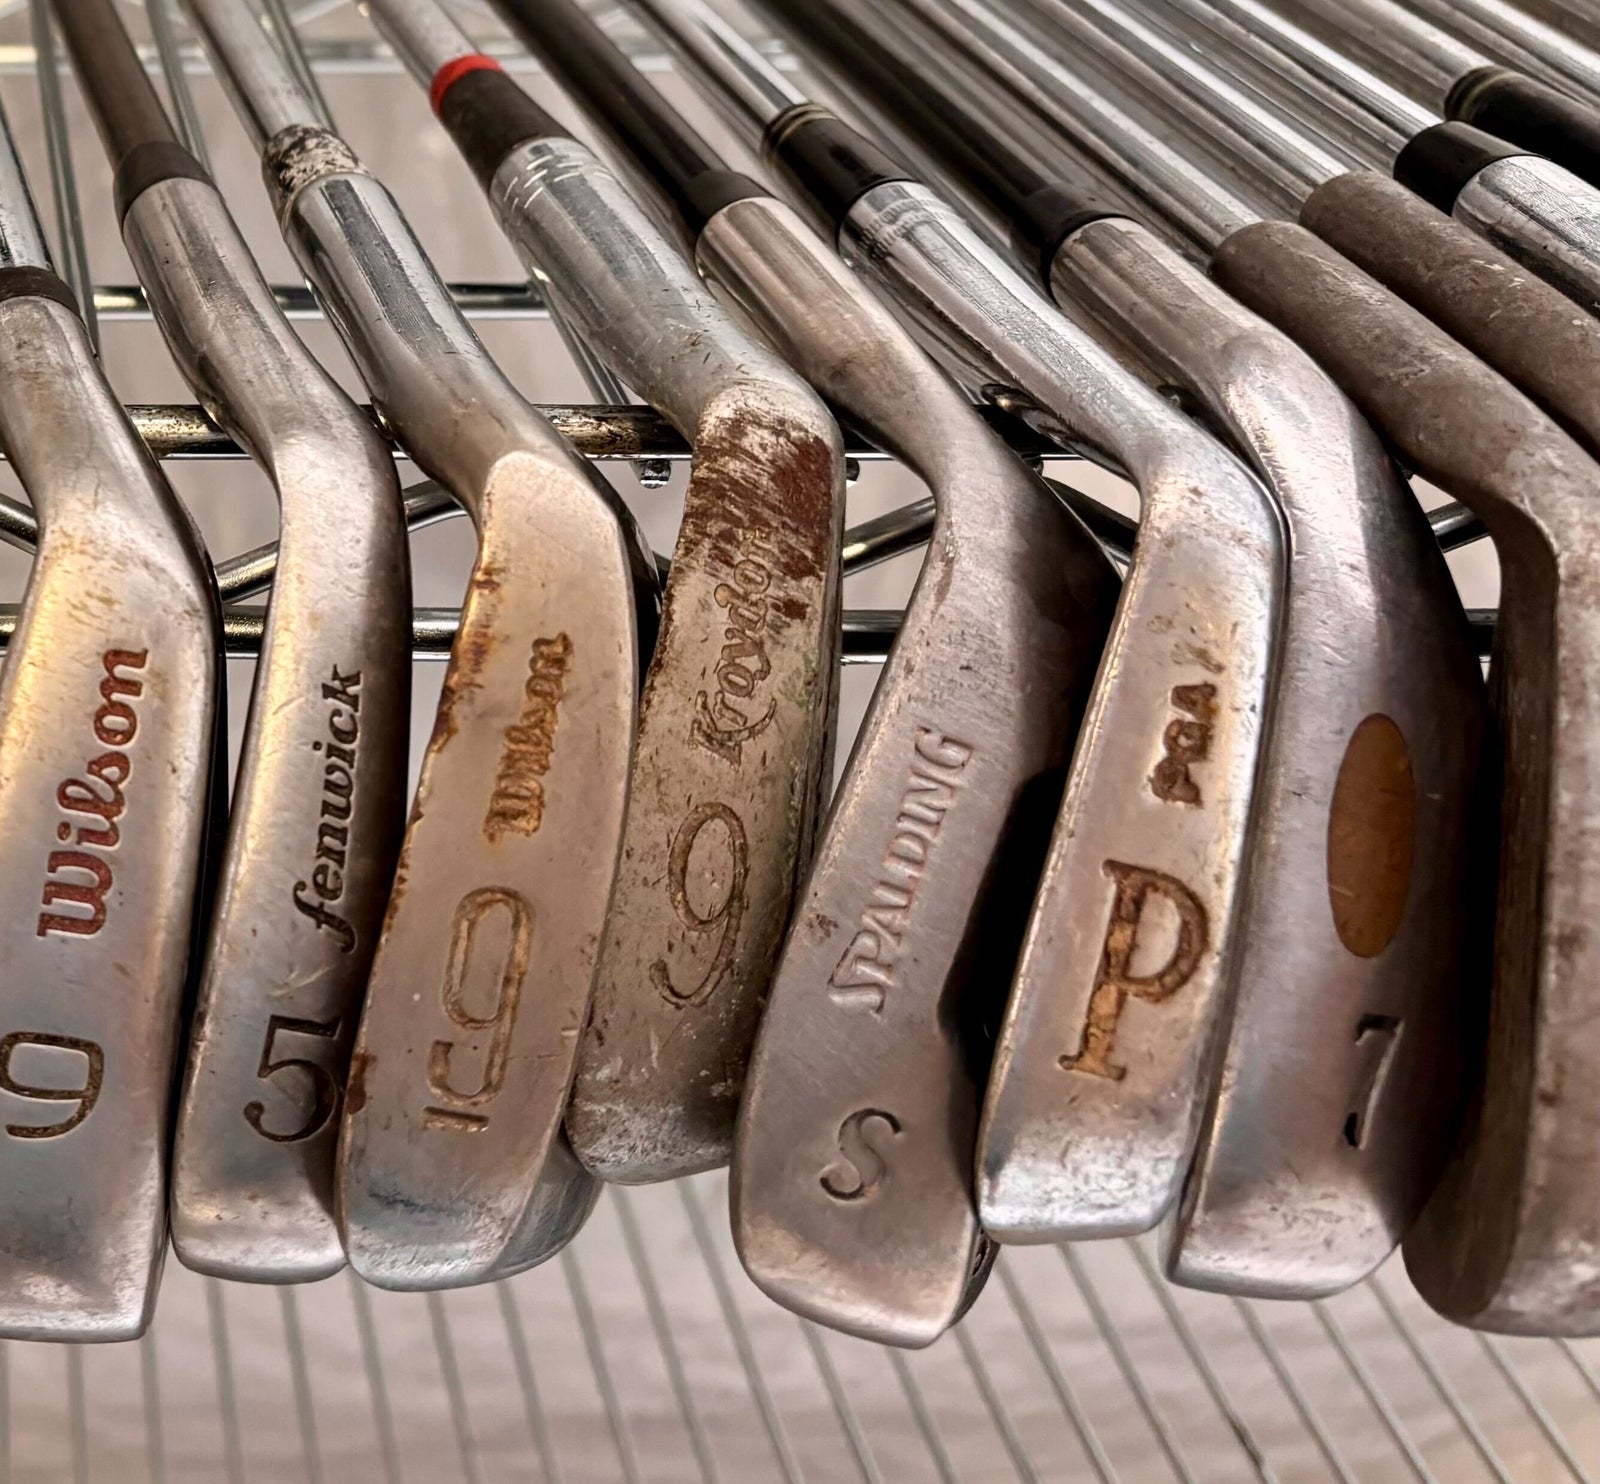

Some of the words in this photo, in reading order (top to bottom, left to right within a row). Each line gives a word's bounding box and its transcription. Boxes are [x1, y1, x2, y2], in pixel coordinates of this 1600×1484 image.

[36, 647, 149, 938] Wilson
[293, 664, 363, 953] fenwick
[483, 632, 574, 841] Wilson
[649, 802, 749, 1008] 9
[828, 727, 975, 1016] SPALDING
[1058, 859, 1210, 1081] P
[244, 1013, 342, 1142] 5
[428, 885, 533, 1104] 9
[820, 1107, 901, 1200] S
